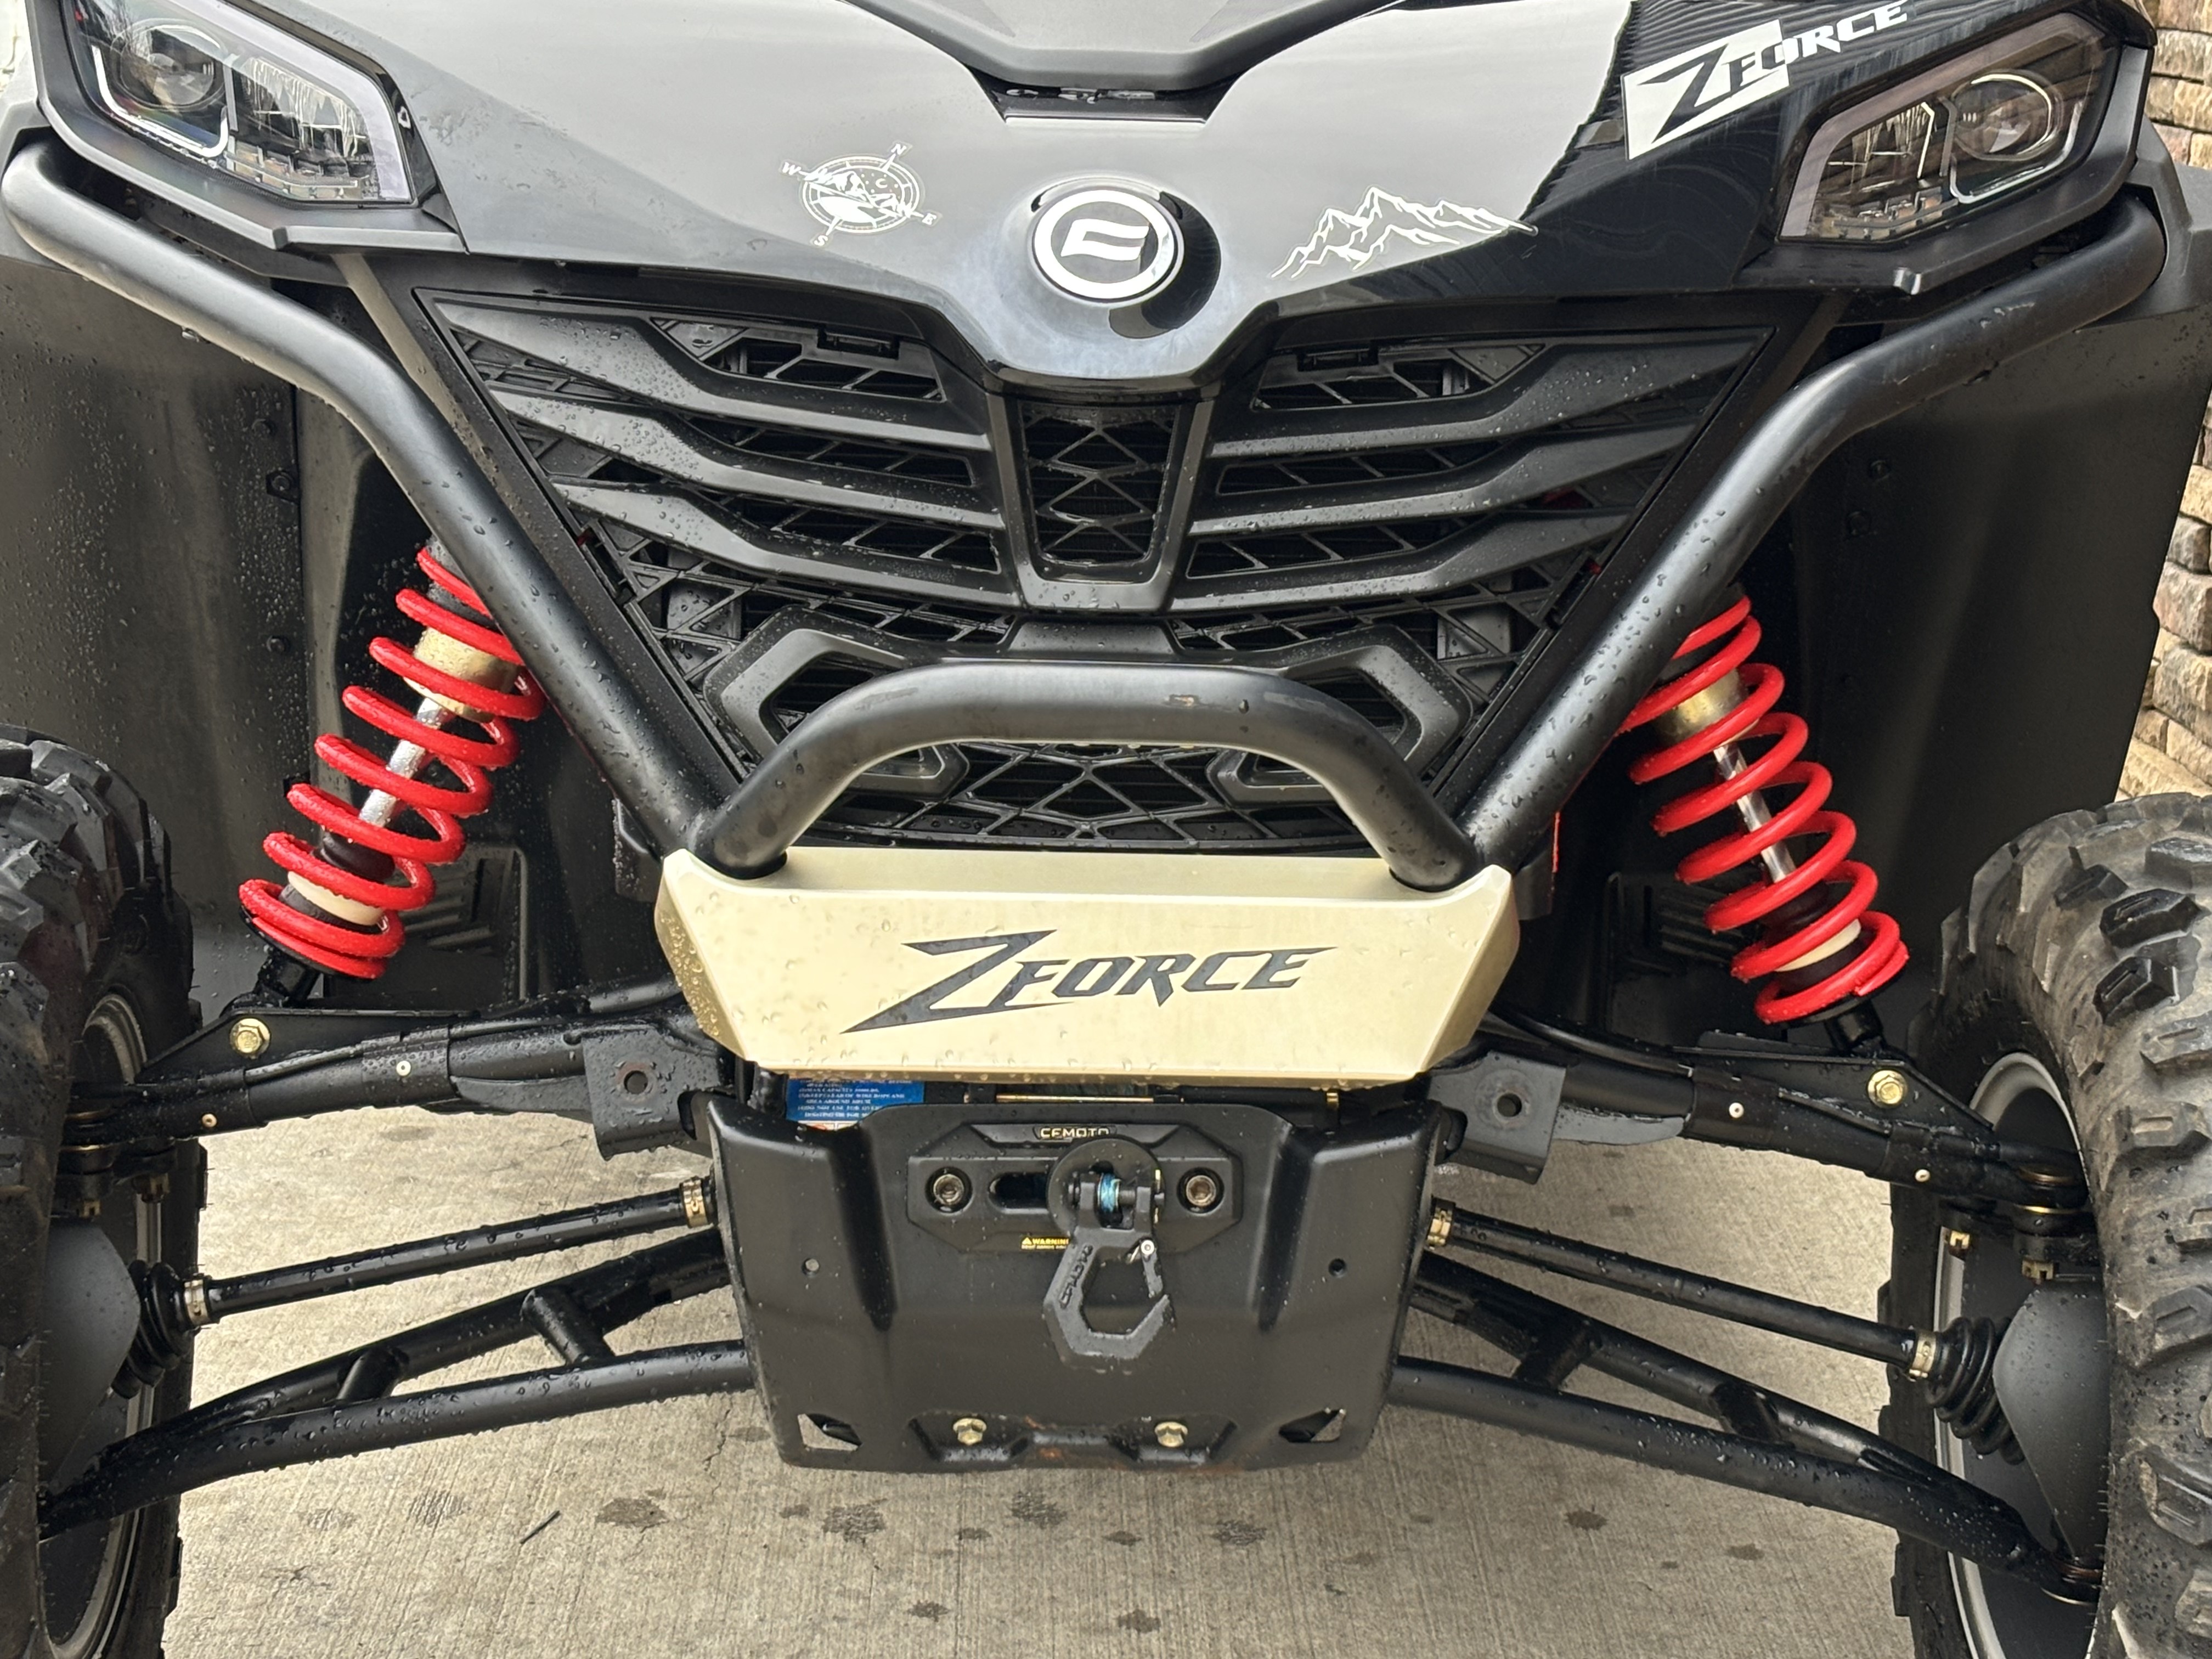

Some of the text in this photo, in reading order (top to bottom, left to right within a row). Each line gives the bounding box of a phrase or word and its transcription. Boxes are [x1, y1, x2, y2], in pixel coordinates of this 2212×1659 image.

[891, 143, 906, 155] N
[782, 162, 802, 175] W
[922, 213, 937, 225] E
[814, 235, 828, 246] S
[1041, 1128, 1109, 1137] CFMOTO
